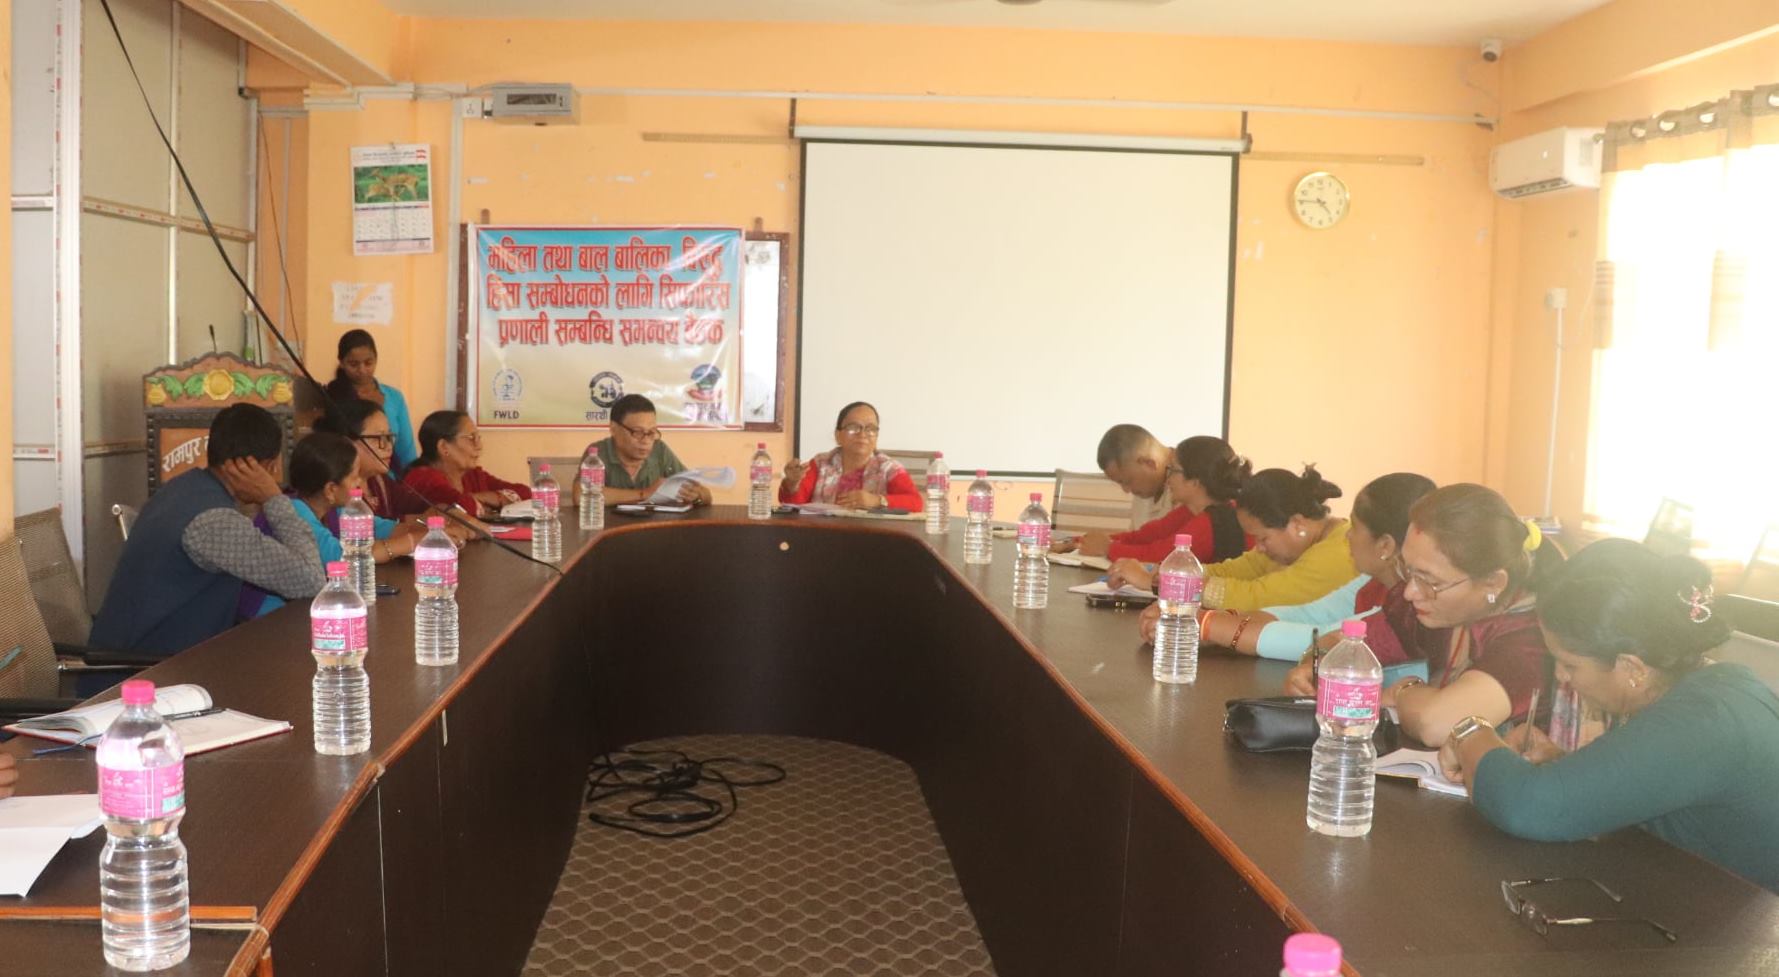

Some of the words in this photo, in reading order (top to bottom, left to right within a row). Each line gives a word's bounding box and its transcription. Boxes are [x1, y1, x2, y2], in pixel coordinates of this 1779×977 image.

[488, 236, 538, 273] महिला
[543, 244, 573, 272] तथा
[578, 244, 610, 273] बाल
[614, 236, 672, 272] बालिका
[526, 273, 610, 310] सम्बोधनको
[615, 273, 655, 310] लागि
[498, 310, 550, 348] प्रणाली
[555, 310, 614, 347] सम्बन्धि
[619, 318, 681, 346] समन्वय
[494, 410, 520, 420] FWLD
[162, 435, 202, 473] रामपुर
